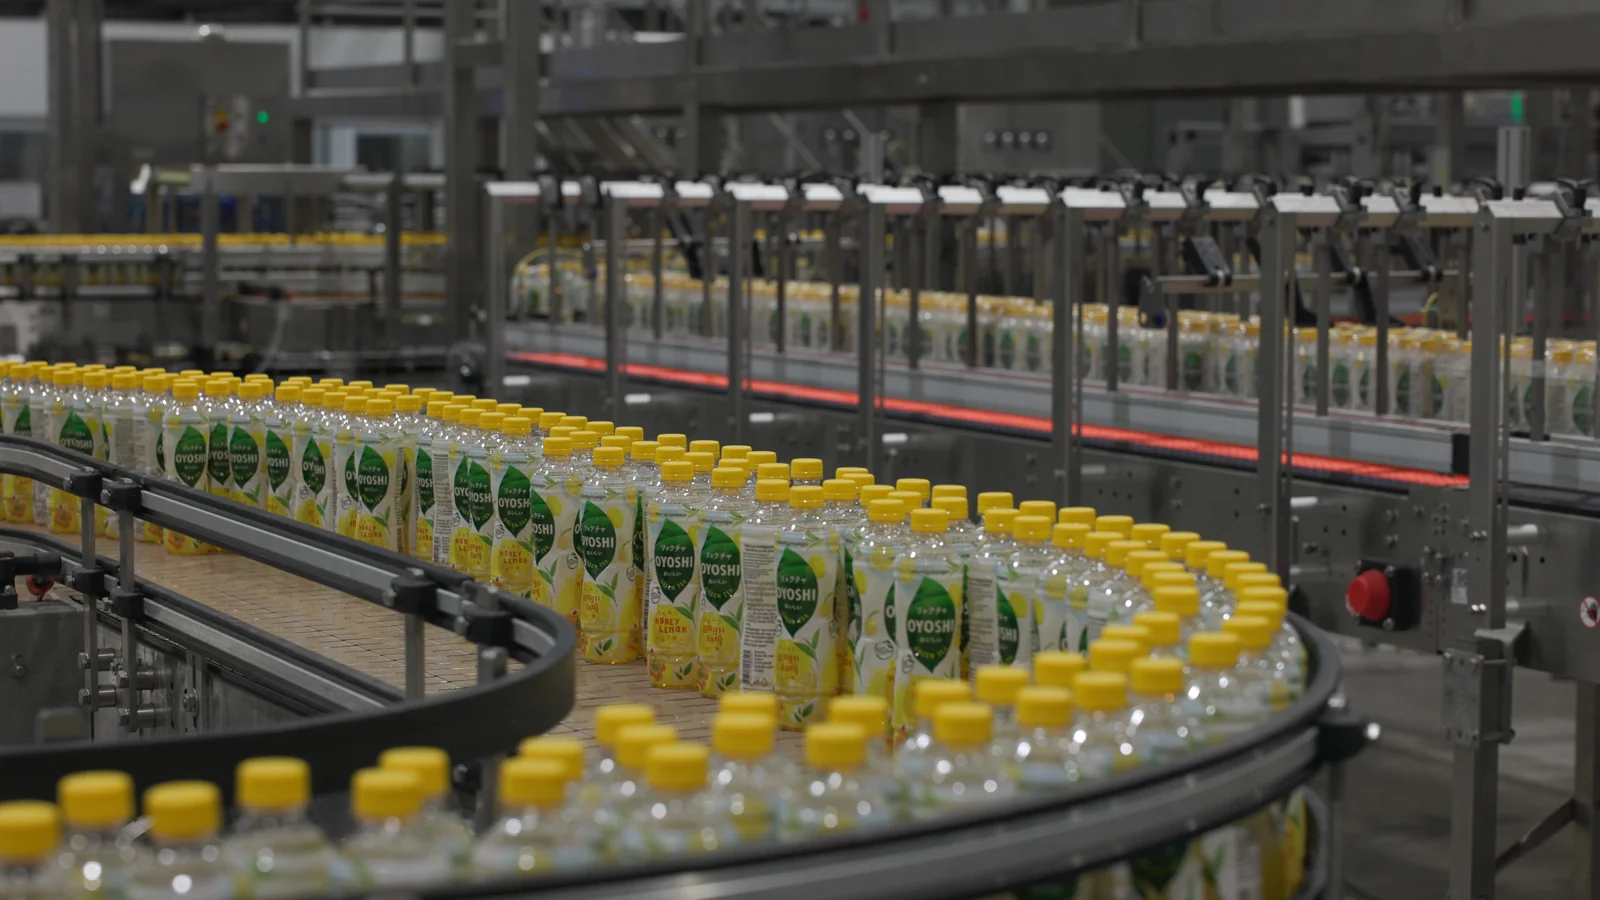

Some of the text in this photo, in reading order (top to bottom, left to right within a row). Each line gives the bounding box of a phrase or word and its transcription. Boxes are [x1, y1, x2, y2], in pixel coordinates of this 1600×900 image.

[359, 474, 388, 485] OYOSHI
[655, 555, 693, 568] OYOSHI
[701, 562, 740, 576] OYOSHI
[776, 587, 816, 601] OYOSHI
[659, 625, 688, 634] LEMON
[907, 619, 954, 634] OYOSHI
